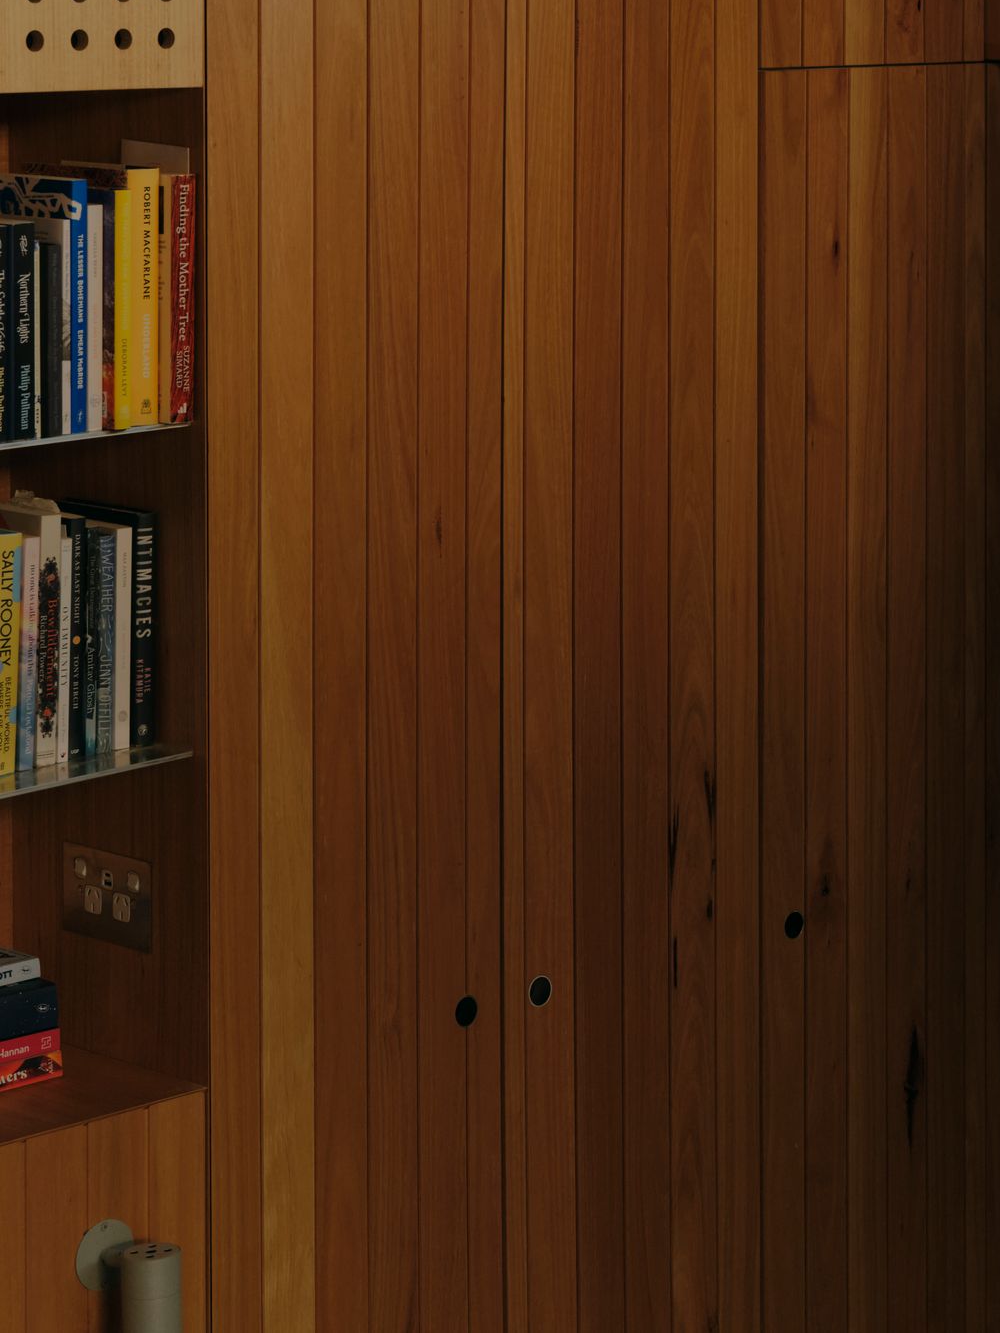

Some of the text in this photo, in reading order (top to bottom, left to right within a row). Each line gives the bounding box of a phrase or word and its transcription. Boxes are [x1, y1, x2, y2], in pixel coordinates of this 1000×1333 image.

[143, 186, 151, 225] ROBERT
[143, 229, 151, 300] MACFARLANE
[176, 184, 190, 342] Finding the Mother Tree
[17, 272, 32, 314] Northern
[16, 313, 31, 344] Lights
[18, 364, 31, 391] Philip
[20, 392, 31, 431] Pullman
[74, 560, 81, 571] AS
[136, 526, 153, 639] INTIMACIES
[0, 550, 15, 667] SALLY ROONEY
[27, 602, 36, 632] talking
[62, 606, 70, 623] ON
[73, 596, 81, 624] NIGHT
[39, 615, 48, 683] Richard Powers
[46, 599, 58, 697] Bewilderment
[60, 627, 69, 687] IMMUNITY
[98, 552, 114, 733] WEATHER JENNY OFFILL
[27, 659, 35, 676] this
[72, 655, 80, 678] TONY
[87, 647, 95, 682] Amitav
[136, 658, 144, 705] KITAMURA
[143, 667, 152, 694] KATIE
[4, 676, 12, 719] BEAUTIFUL
[25, 679, 34, 708] Patricia
[86, 684, 95, 714] Ghosh
[24, 709, 33, 754] Lockwood
